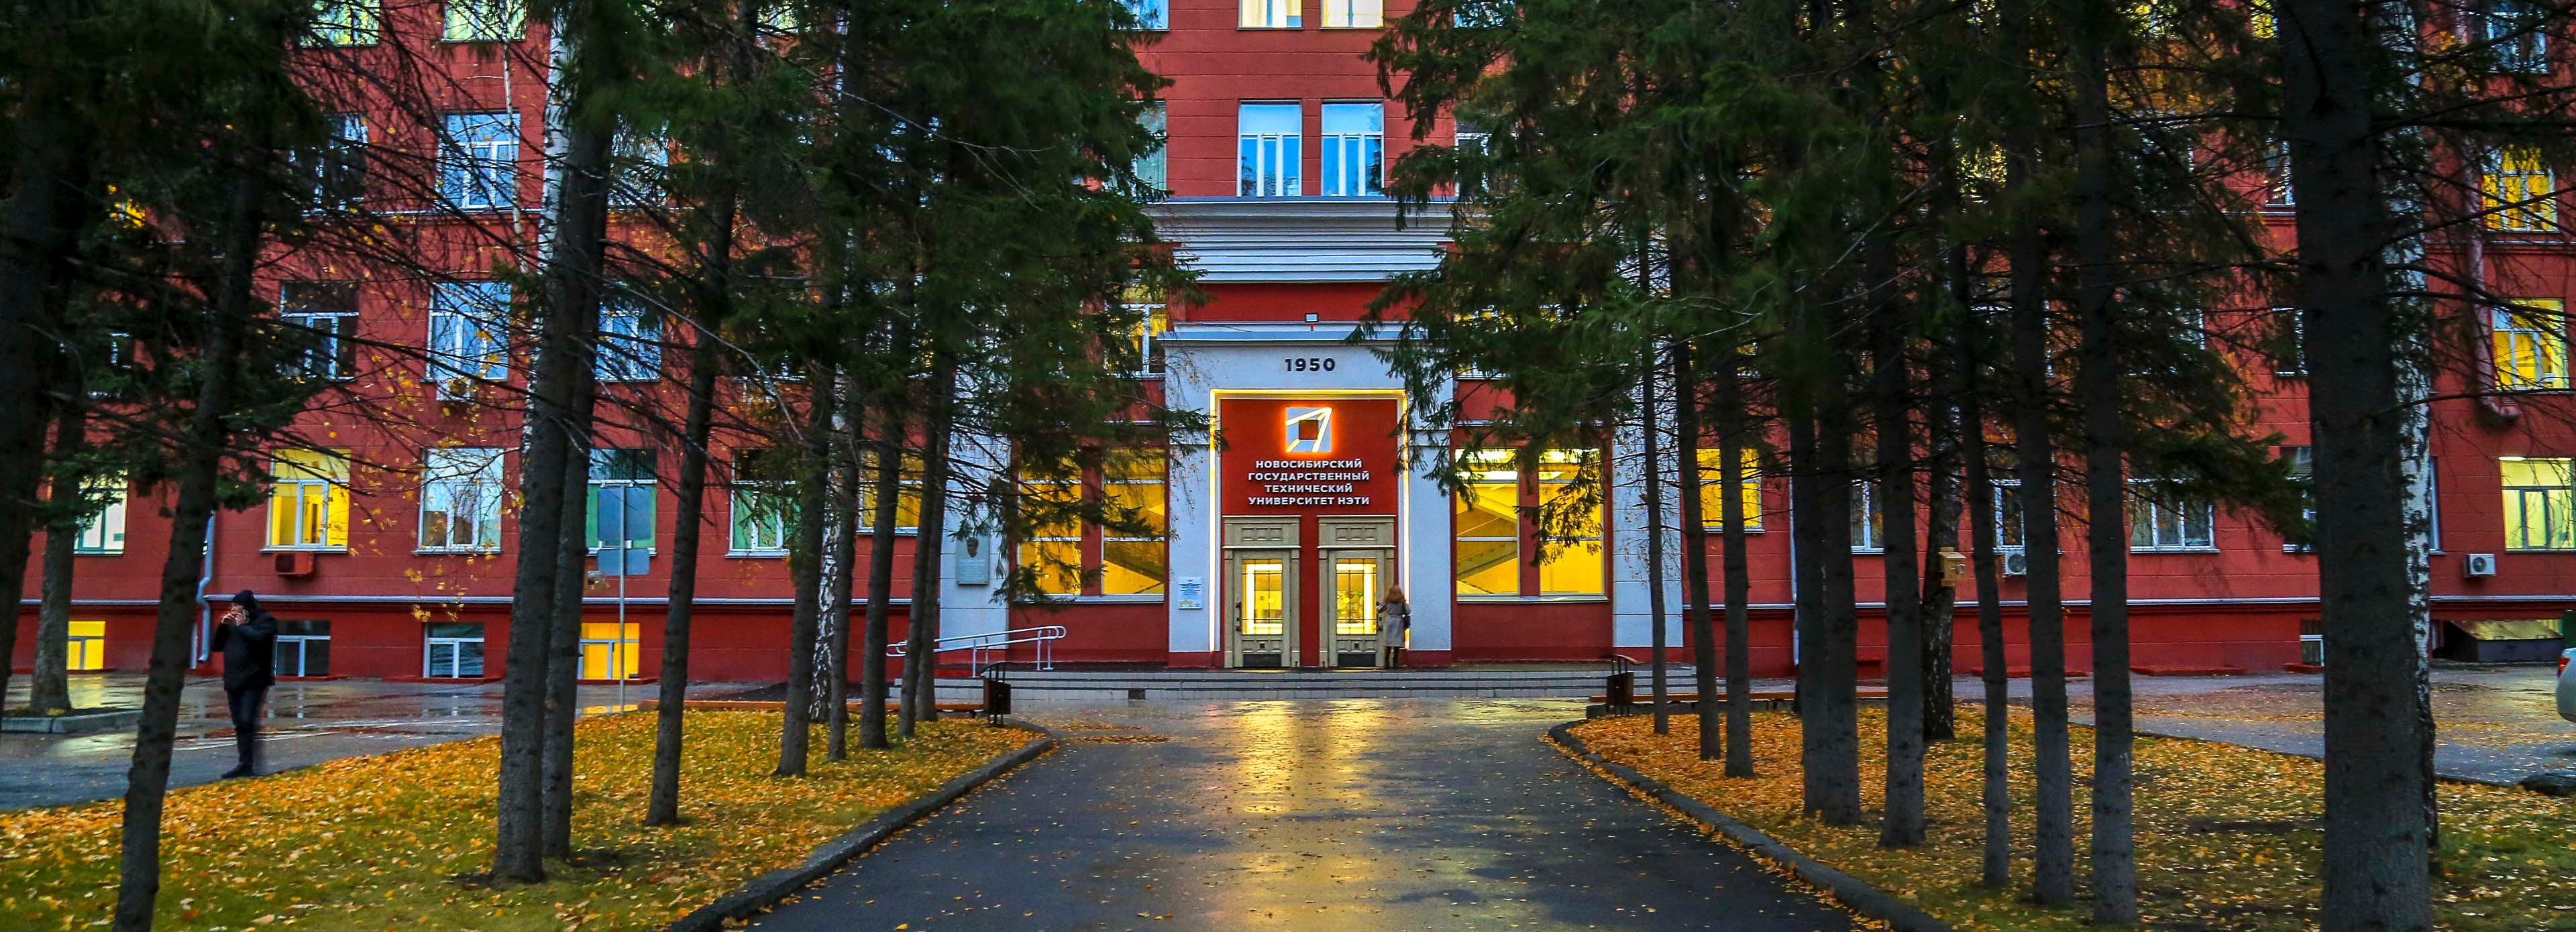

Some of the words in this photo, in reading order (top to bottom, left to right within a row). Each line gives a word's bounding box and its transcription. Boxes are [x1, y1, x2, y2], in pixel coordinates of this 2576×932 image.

[1285, 357, 1336, 371] 1950
[1255, 459, 1362, 468] НОВОСИБИРСКИЙ
[1248, 471, 1369, 481] ГОСУДАРСТВЕННЫЙ
[1265, 483, 1353, 493] ТЕХНИЧЕСКИЙ
[1248, 497, 1334, 505] УНИВЕРСИТЕТ
[1338, 497, 1369, 505] НЭТИ
